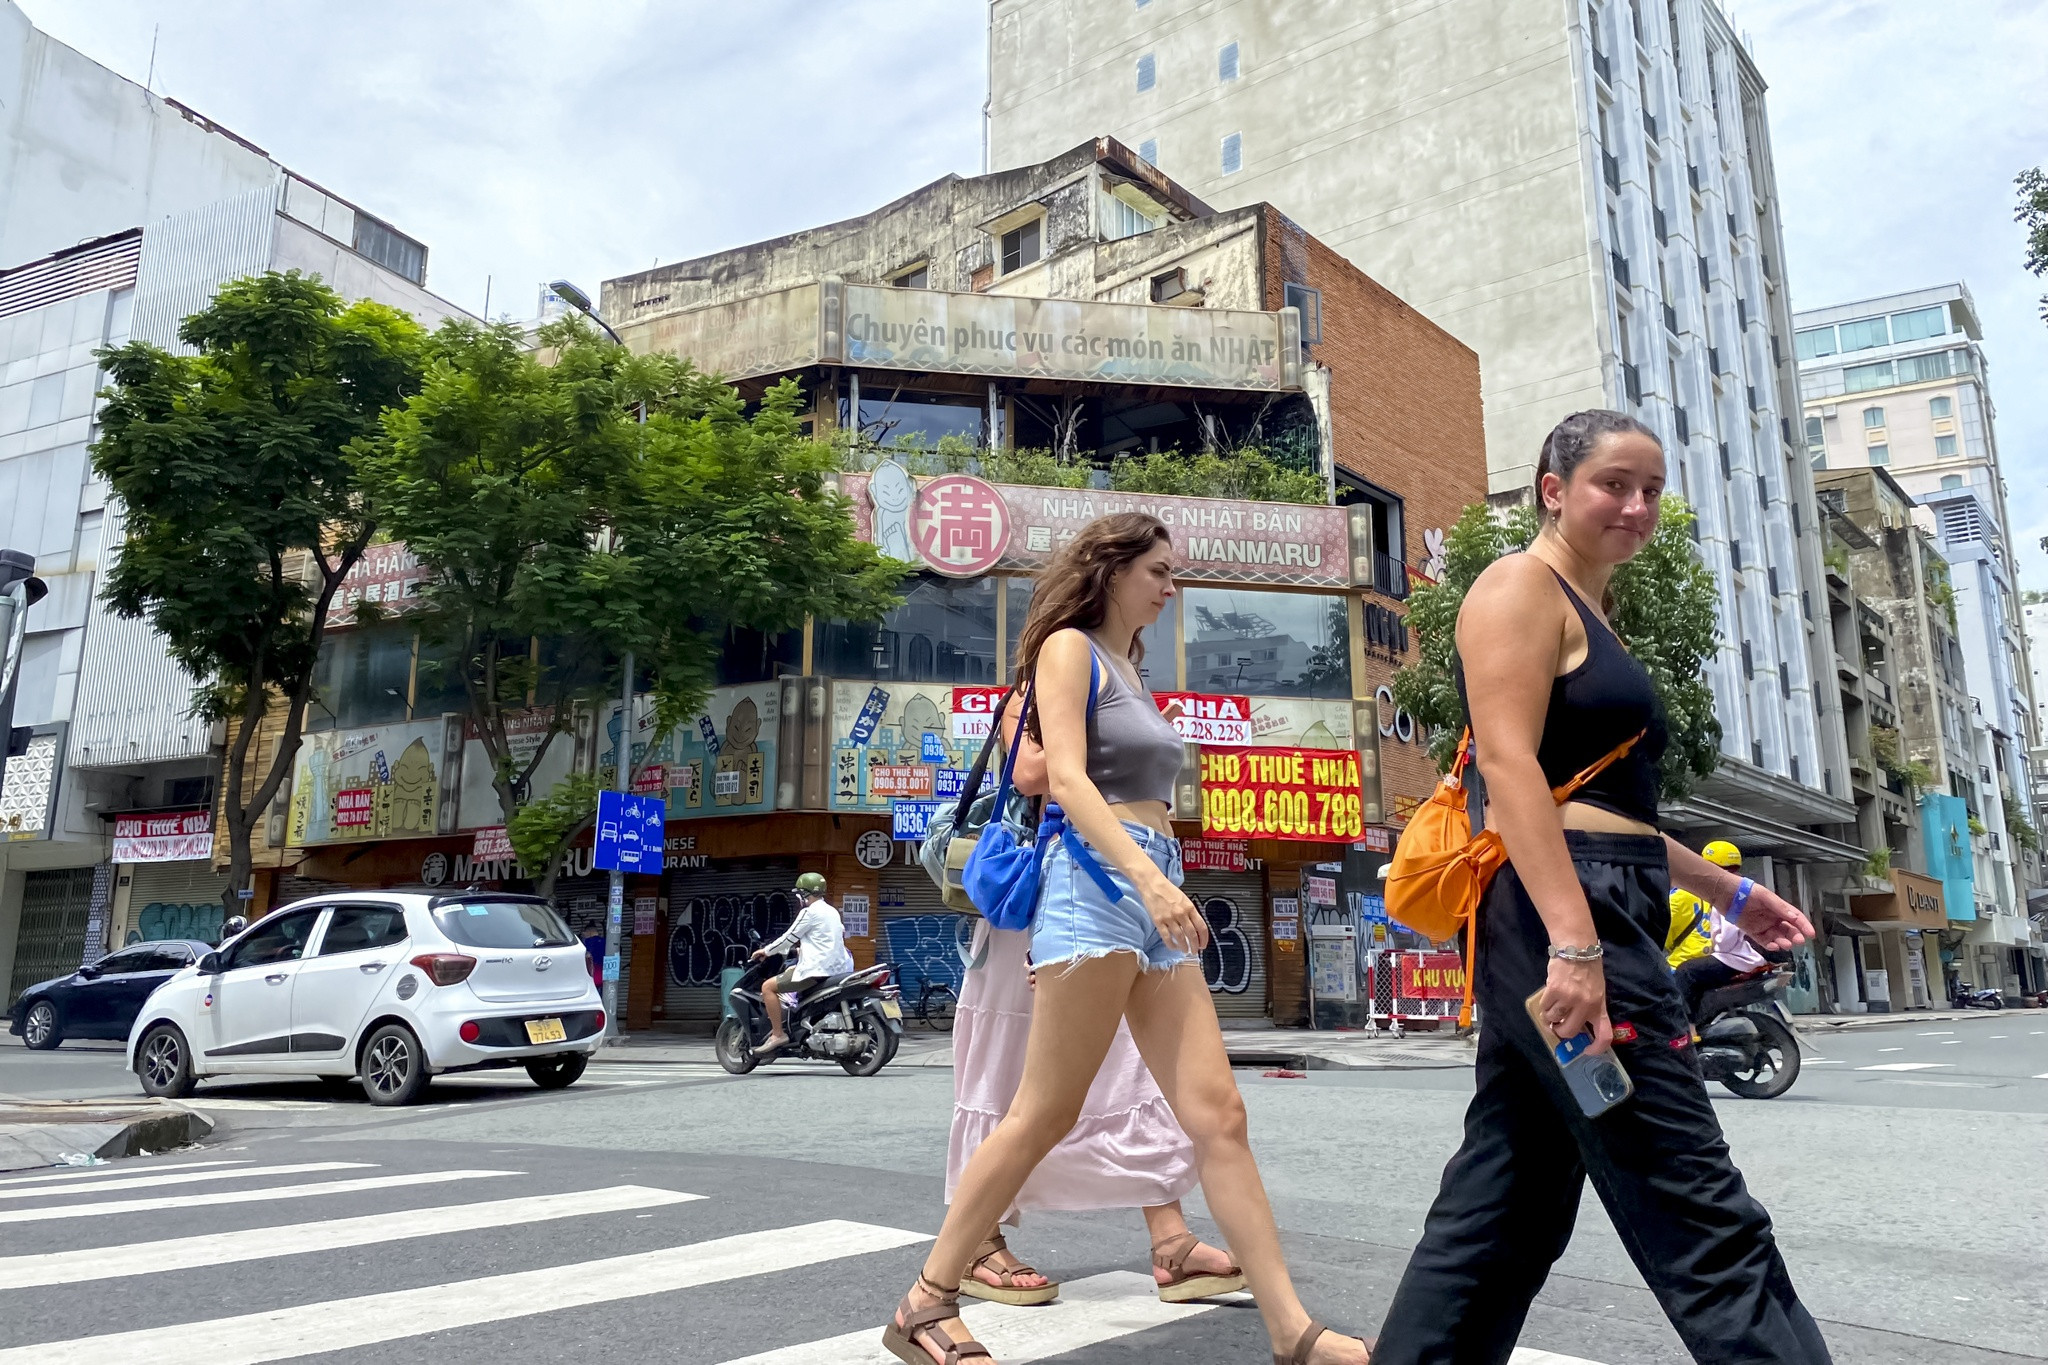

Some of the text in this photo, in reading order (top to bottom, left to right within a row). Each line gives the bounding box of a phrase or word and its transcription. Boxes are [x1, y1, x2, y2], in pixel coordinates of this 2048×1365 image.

[847, 311, 1276, 375] Chuyên phục vụ các món ăn NHẬT
[918, 485, 994, 560] 満
[1043, 497, 1302, 533] NHÀ HÀNG NHẬT BẢN
[1188, 536, 1322, 569] MANMARU
[1171, 720, 1245, 742] 2.228.228
[924, 744, 947, 757] 0936.
[874, 767, 929, 777] CHO THUÊ NHÀ
[938, 770, 970, 781] CHO THU
[1200, 751, 1360, 788] CHO THUÊ NHÀ
[874, 777, 930, 790] 0906.98.0017
[338, 792, 354, 809] NHÀ
[895, 804, 939, 813] CHO THU
[1201, 788, 1362, 837] 0908.600.788
[115, 812, 211, 837] CHO THUÊ NHÀ
[857, 834, 891, 867] 満
[1184, 839, 1245, 852] CHO THUÊ NHÀ
[1184, 849, 1245, 866] 0911 7777 69
[1413, 969, 1440, 988] KHU
